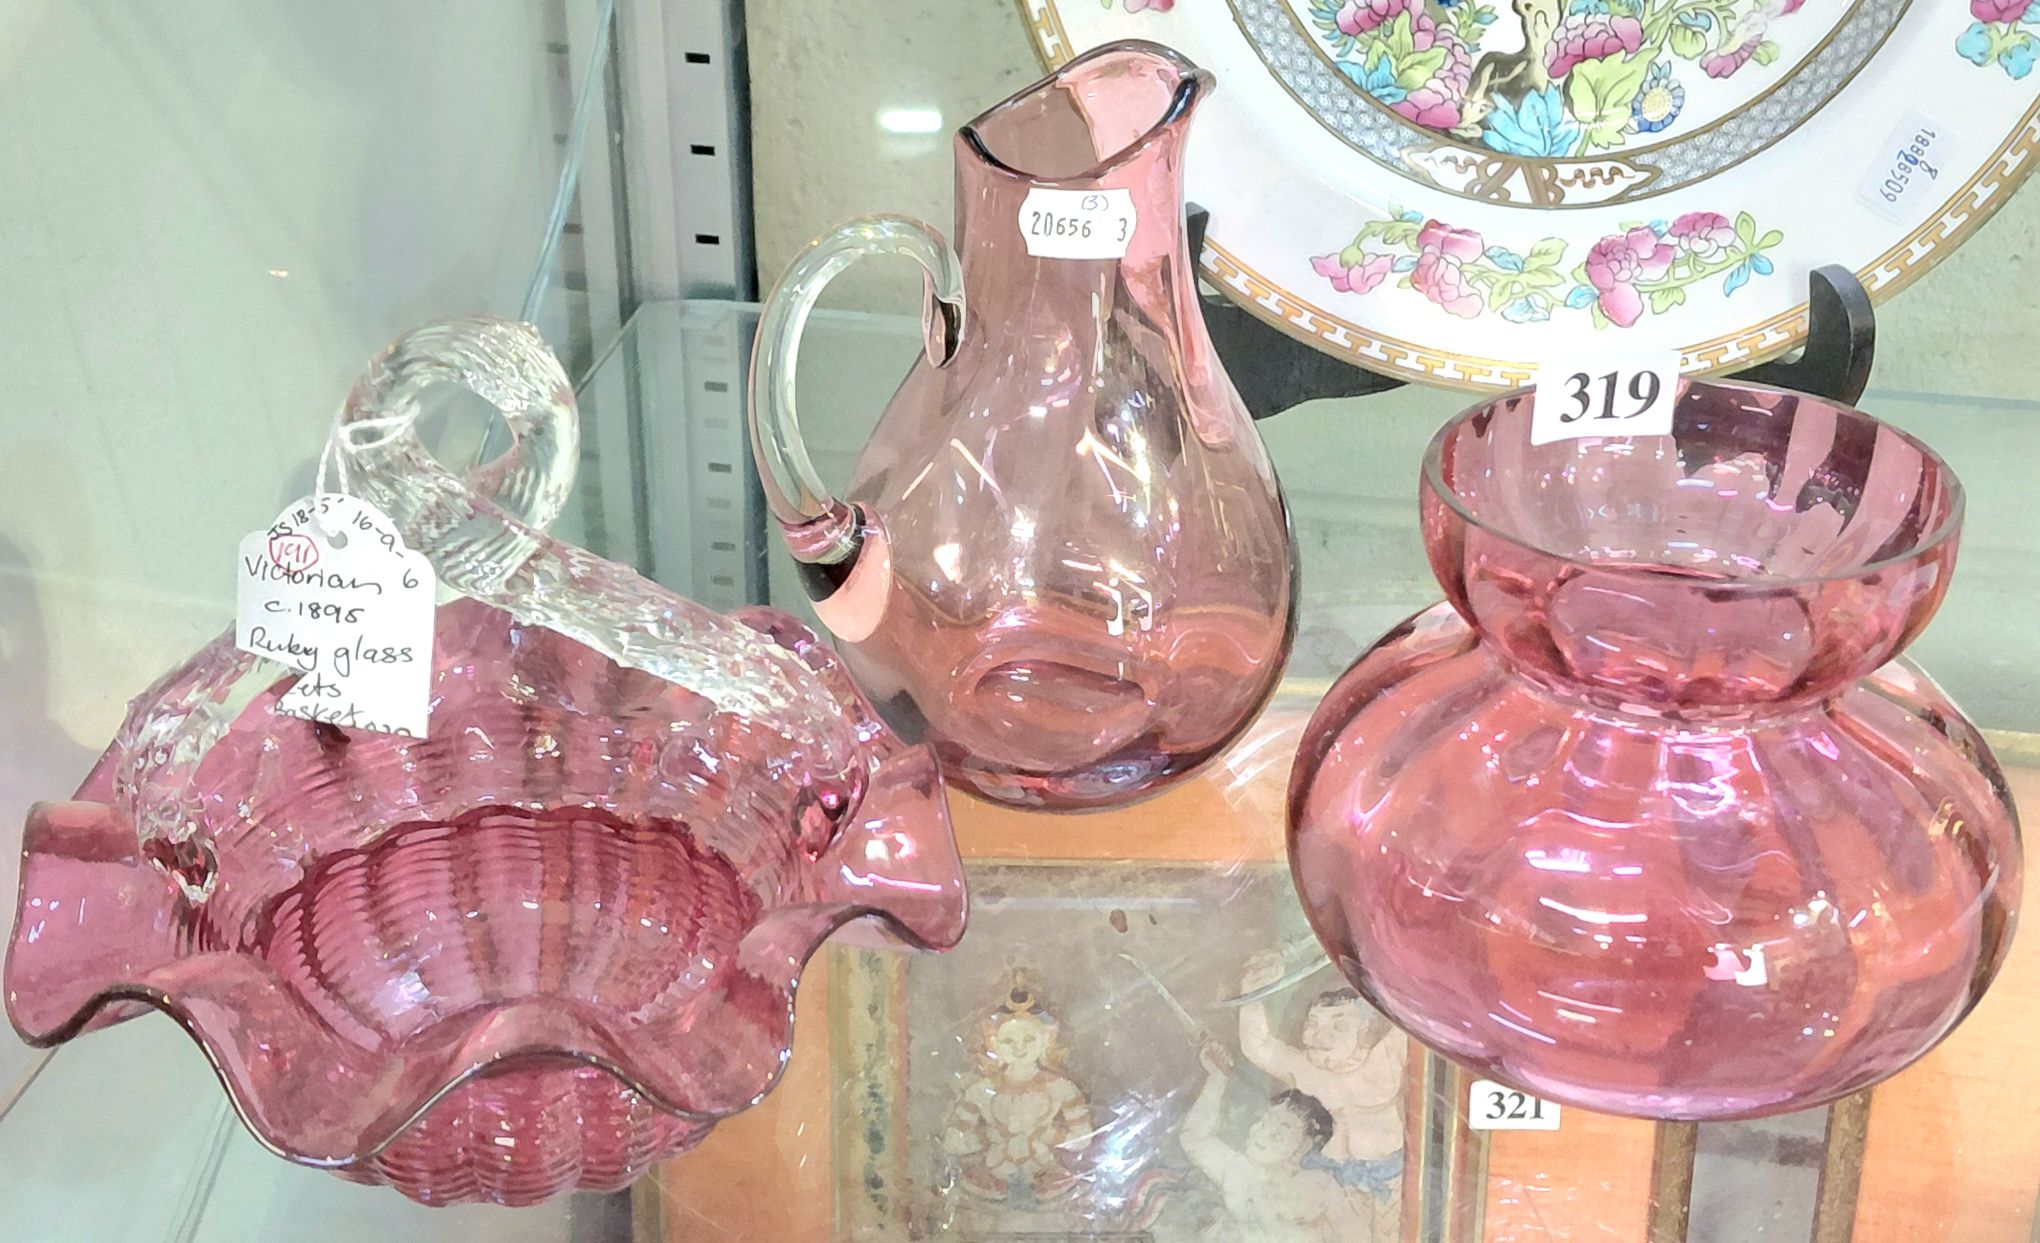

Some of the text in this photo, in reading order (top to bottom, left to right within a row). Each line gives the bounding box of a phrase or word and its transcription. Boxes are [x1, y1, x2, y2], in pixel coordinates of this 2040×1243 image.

[1031, 211, 1128, 242] 20656 3
[1560, 370, 1661, 423] 319
[245, 554, 382, 595] Victorian
[249, 626, 414, 678] Ruby glass
[1486, 1091, 1545, 1120] 321
